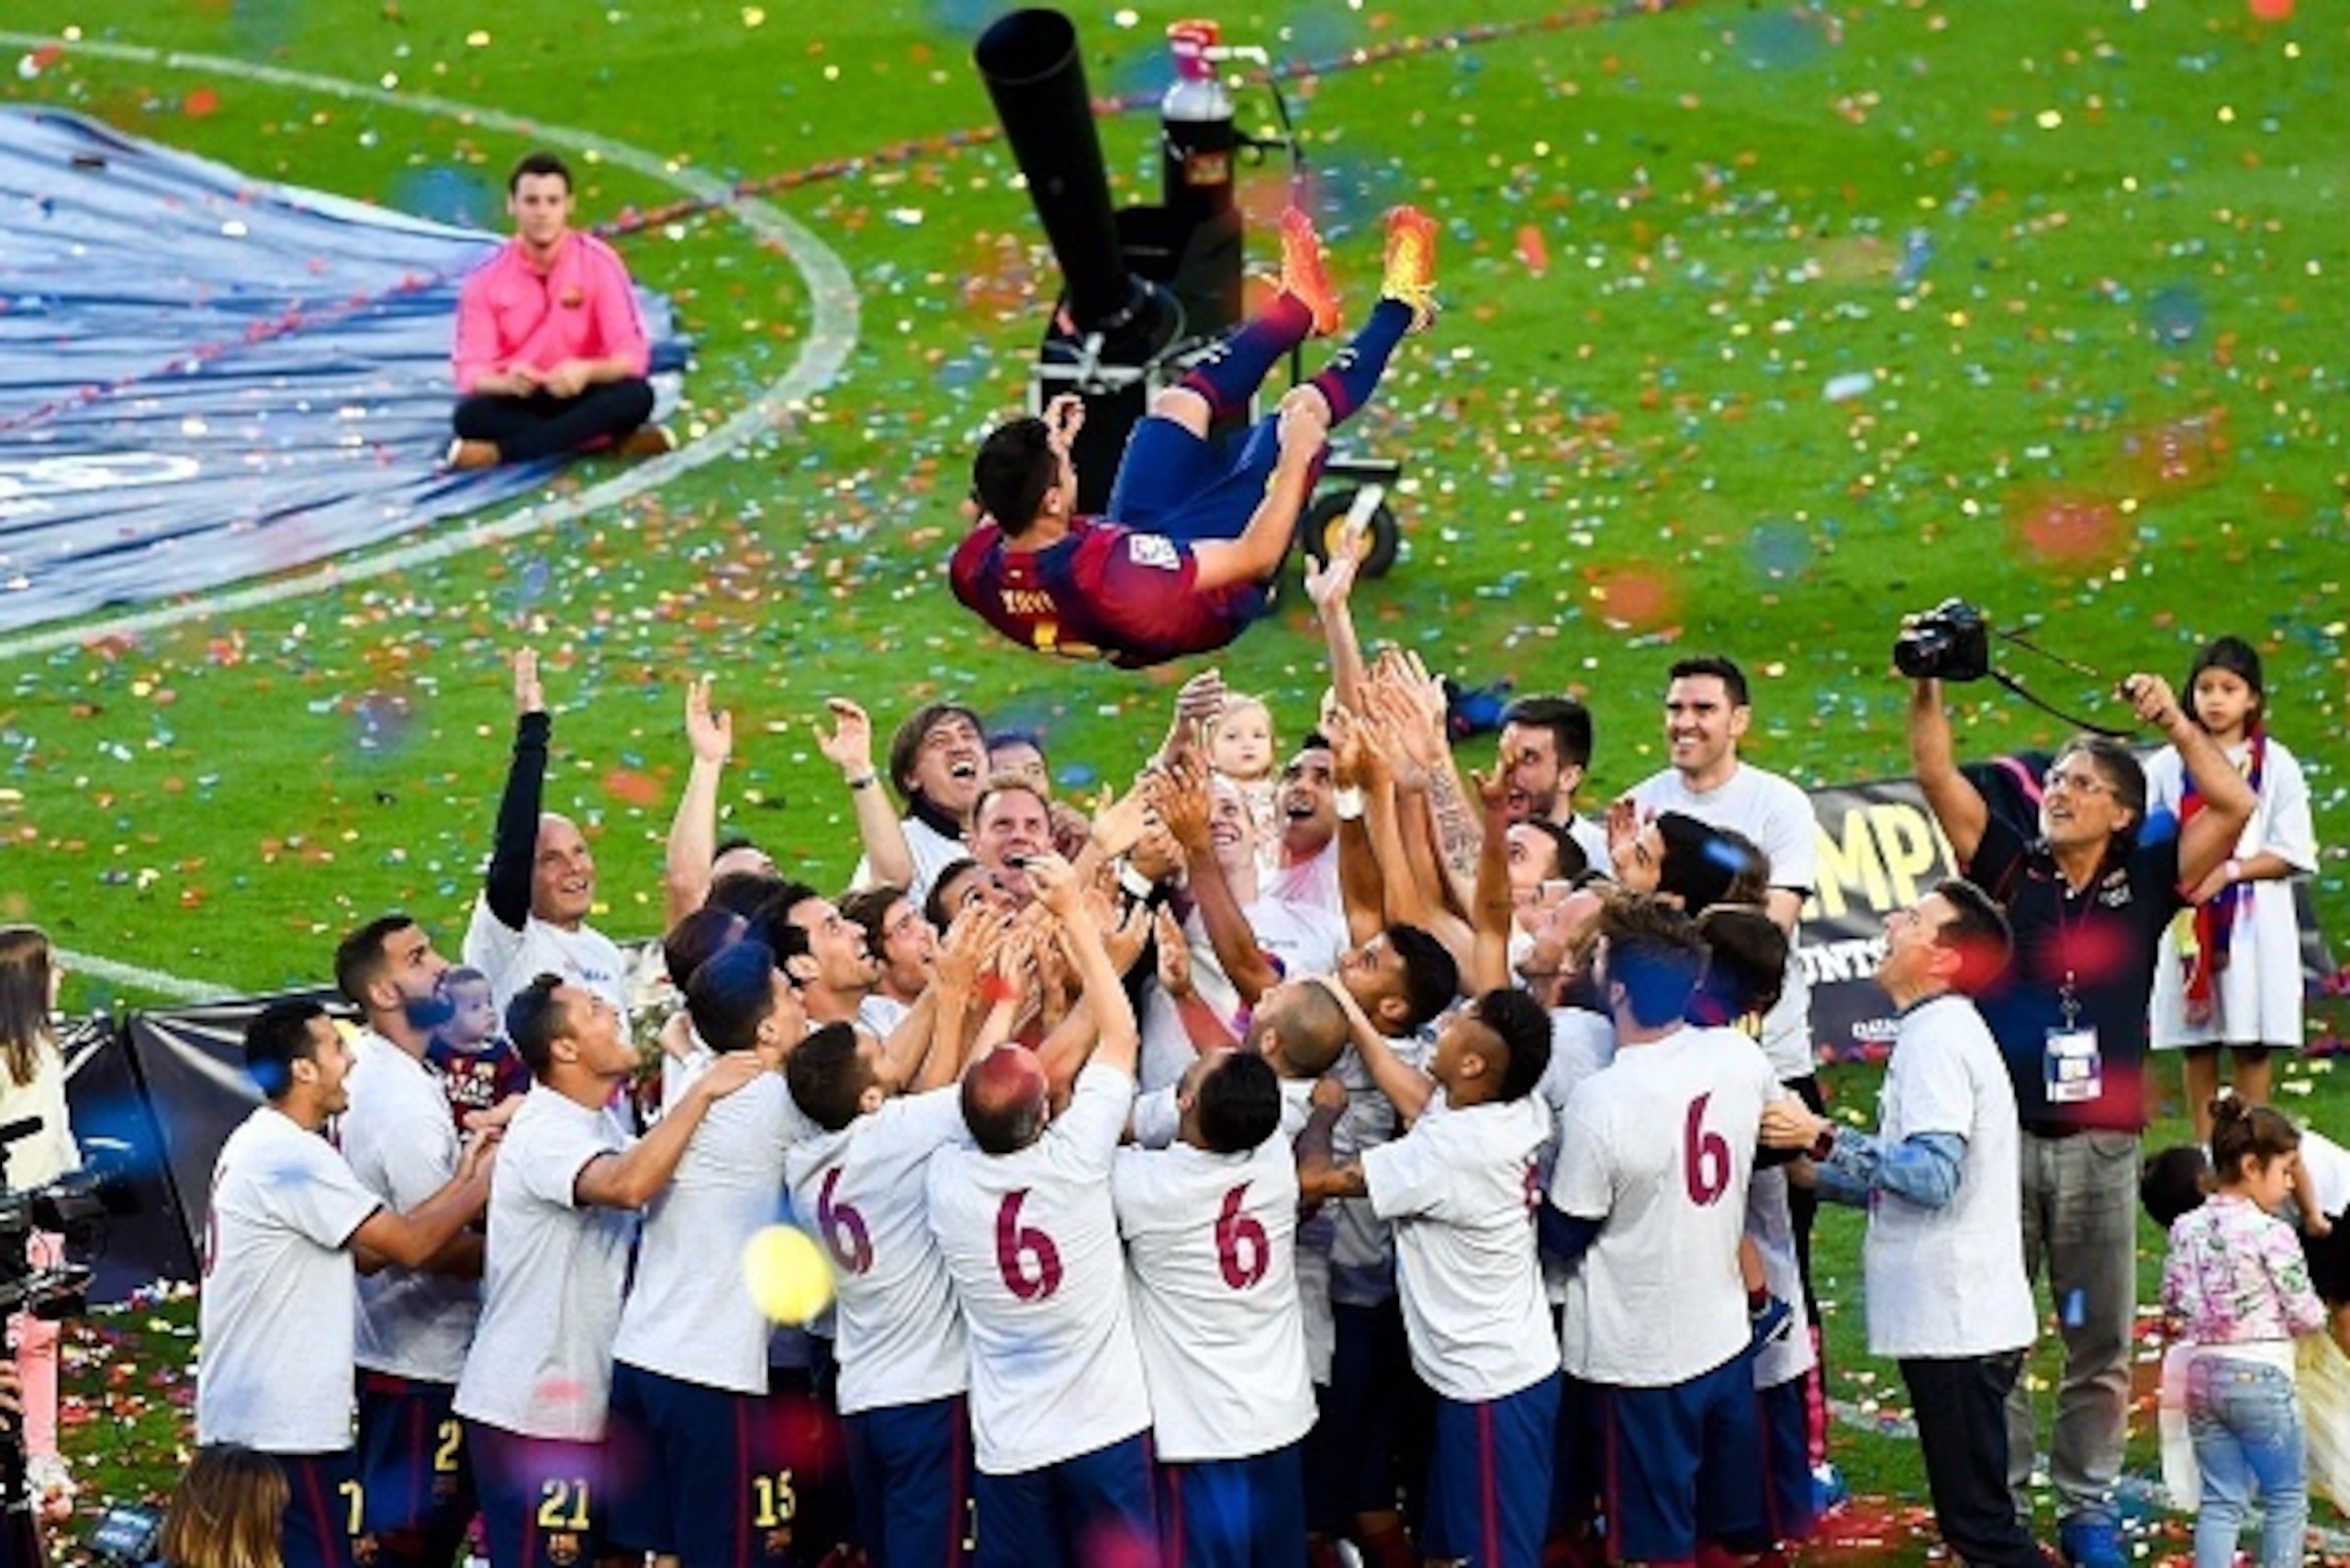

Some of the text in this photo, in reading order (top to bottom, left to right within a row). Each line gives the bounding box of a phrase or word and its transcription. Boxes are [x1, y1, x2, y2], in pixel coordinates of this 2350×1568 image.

[1685, 1090, 1732, 1207] 6
[816, 1166, 875, 1276] 6
[996, 1187, 1065, 1303] 6
[1214, 1179, 1270, 1291] 6
[338, 1479, 365, 1535] 7
[536, 1479, 591, 1531] 21
[752, 1468, 797, 1528] 15
